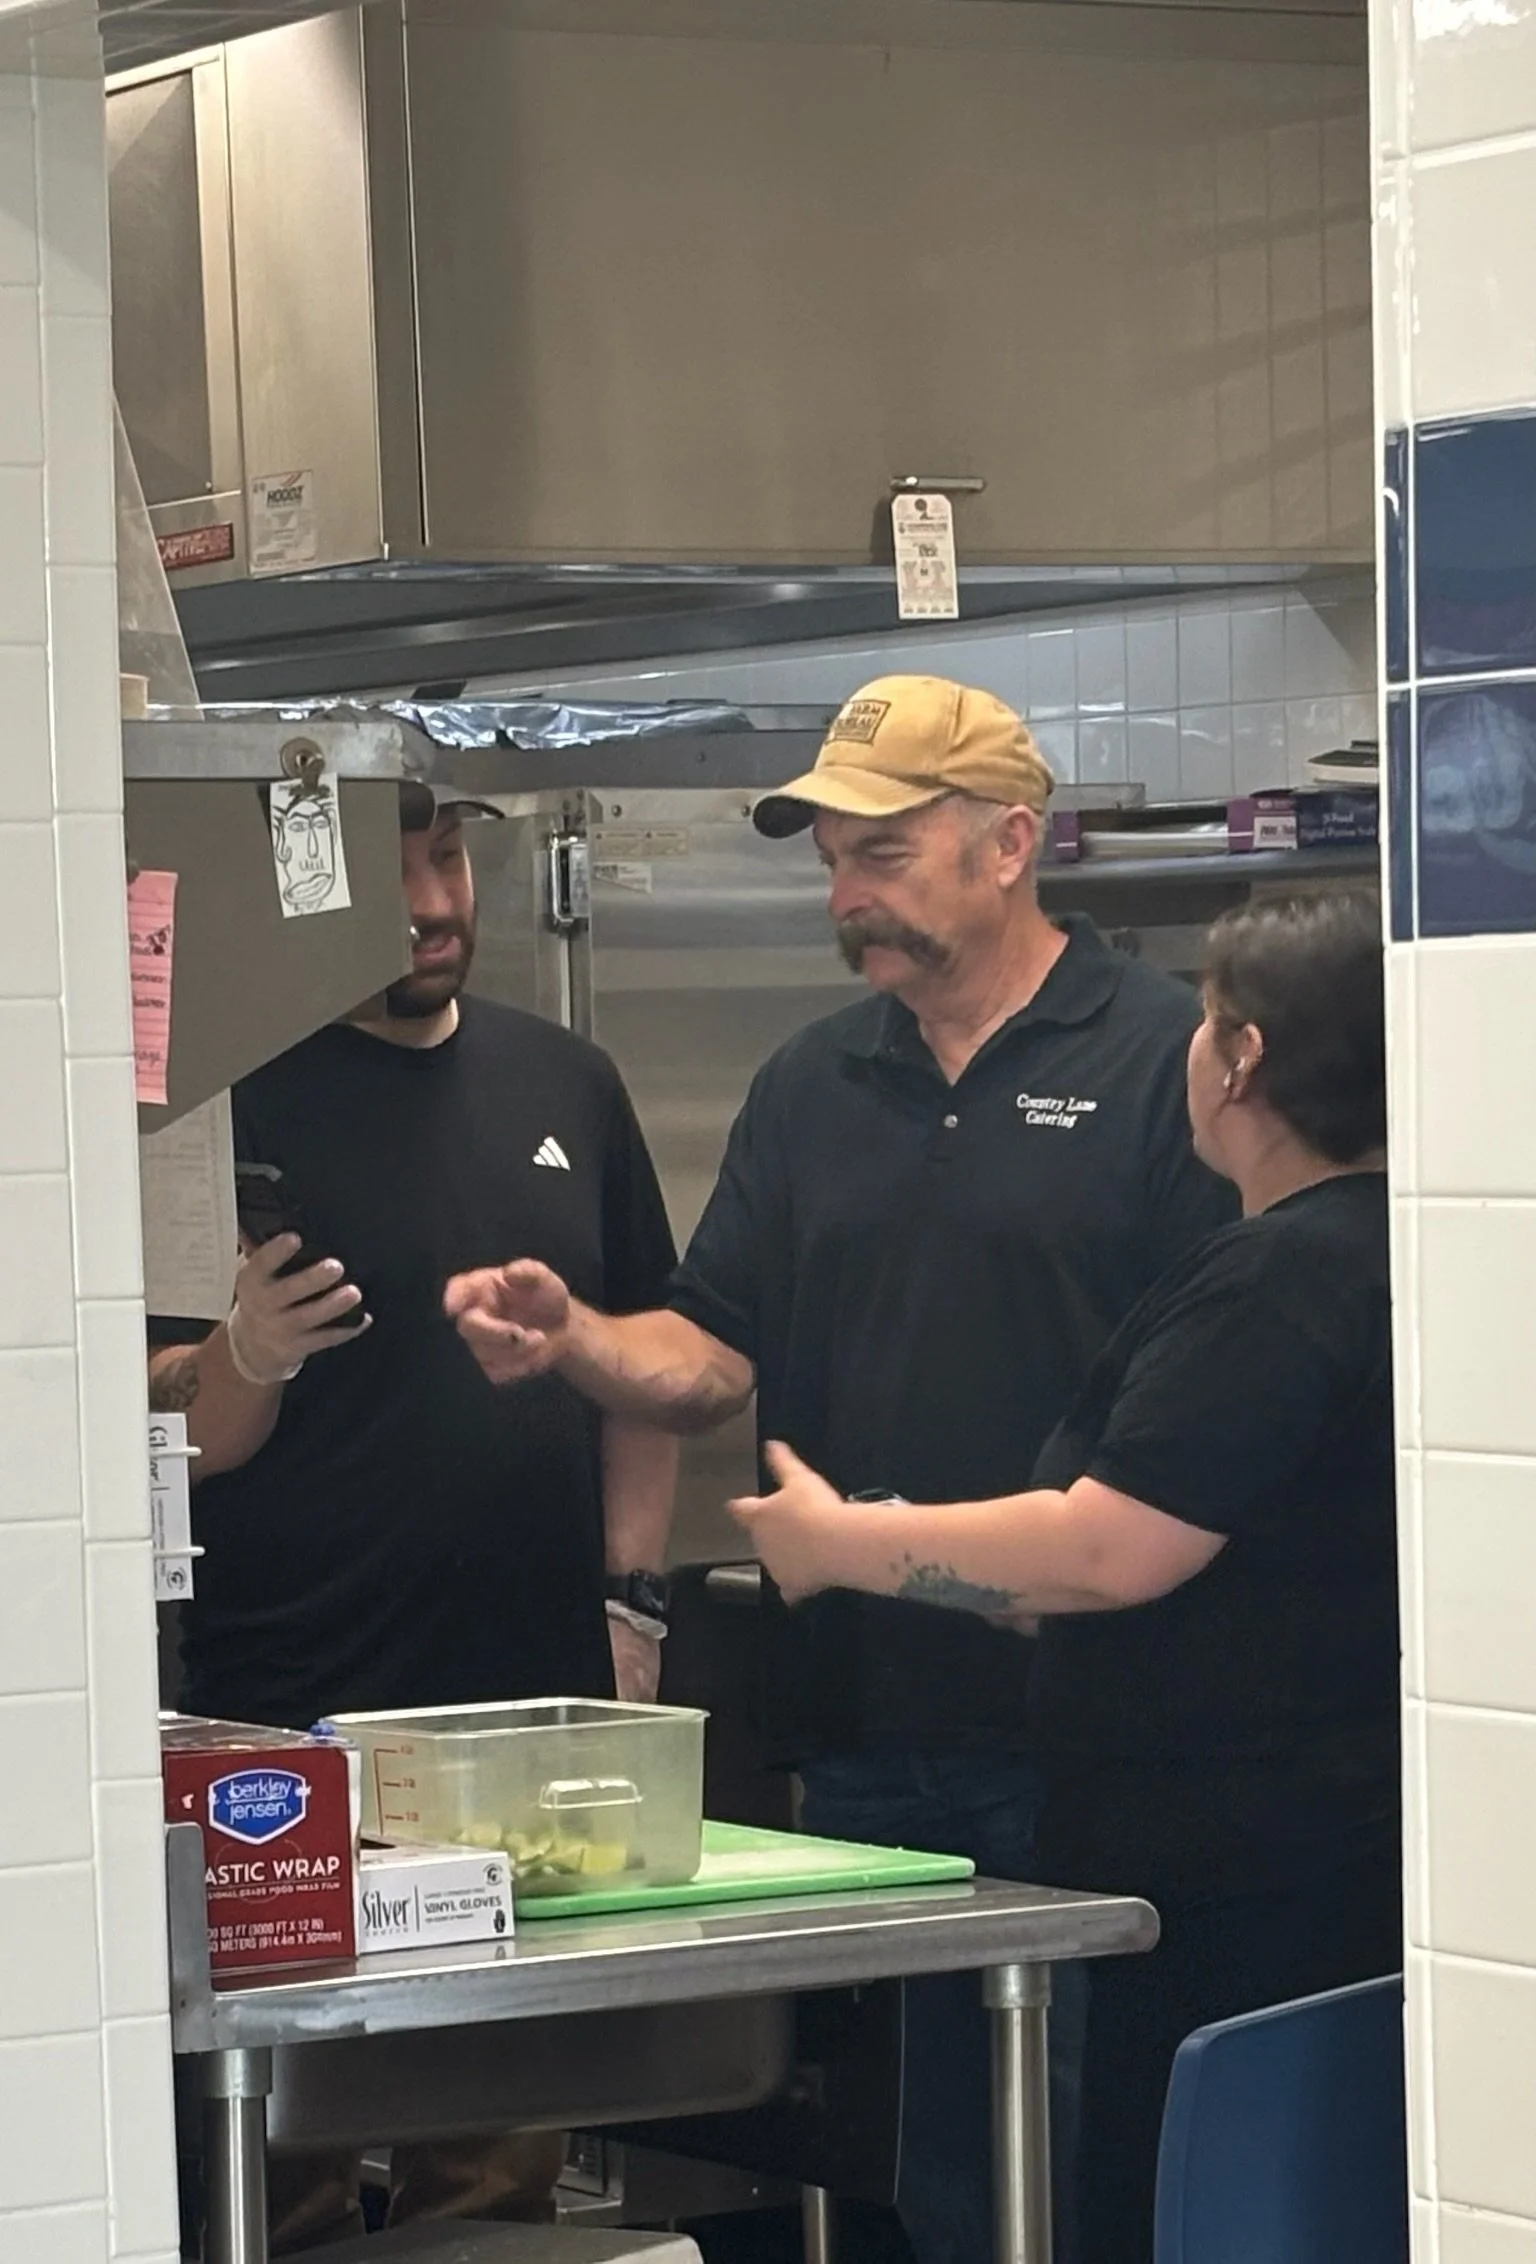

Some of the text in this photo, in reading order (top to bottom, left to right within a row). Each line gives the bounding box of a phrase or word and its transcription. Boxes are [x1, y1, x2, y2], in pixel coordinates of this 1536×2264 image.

[1016, 1093, 1065, 1112] Country
[1025, 1110, 1078, 1129] Catering
[228, 1777, 291, 1799] berkley
[273, 1856, 340, 1880] WRAP
[362, 1890, 410, 1929] Silver
[424, 1895, 502, 1914] VINYL GLOVES
[235, 1924, 247, 1936] FT
[276, 1920, 287, 1934] FT
[298, 1919, 309, 1931] 12
[221, 1937, 257, 1952] METERS
